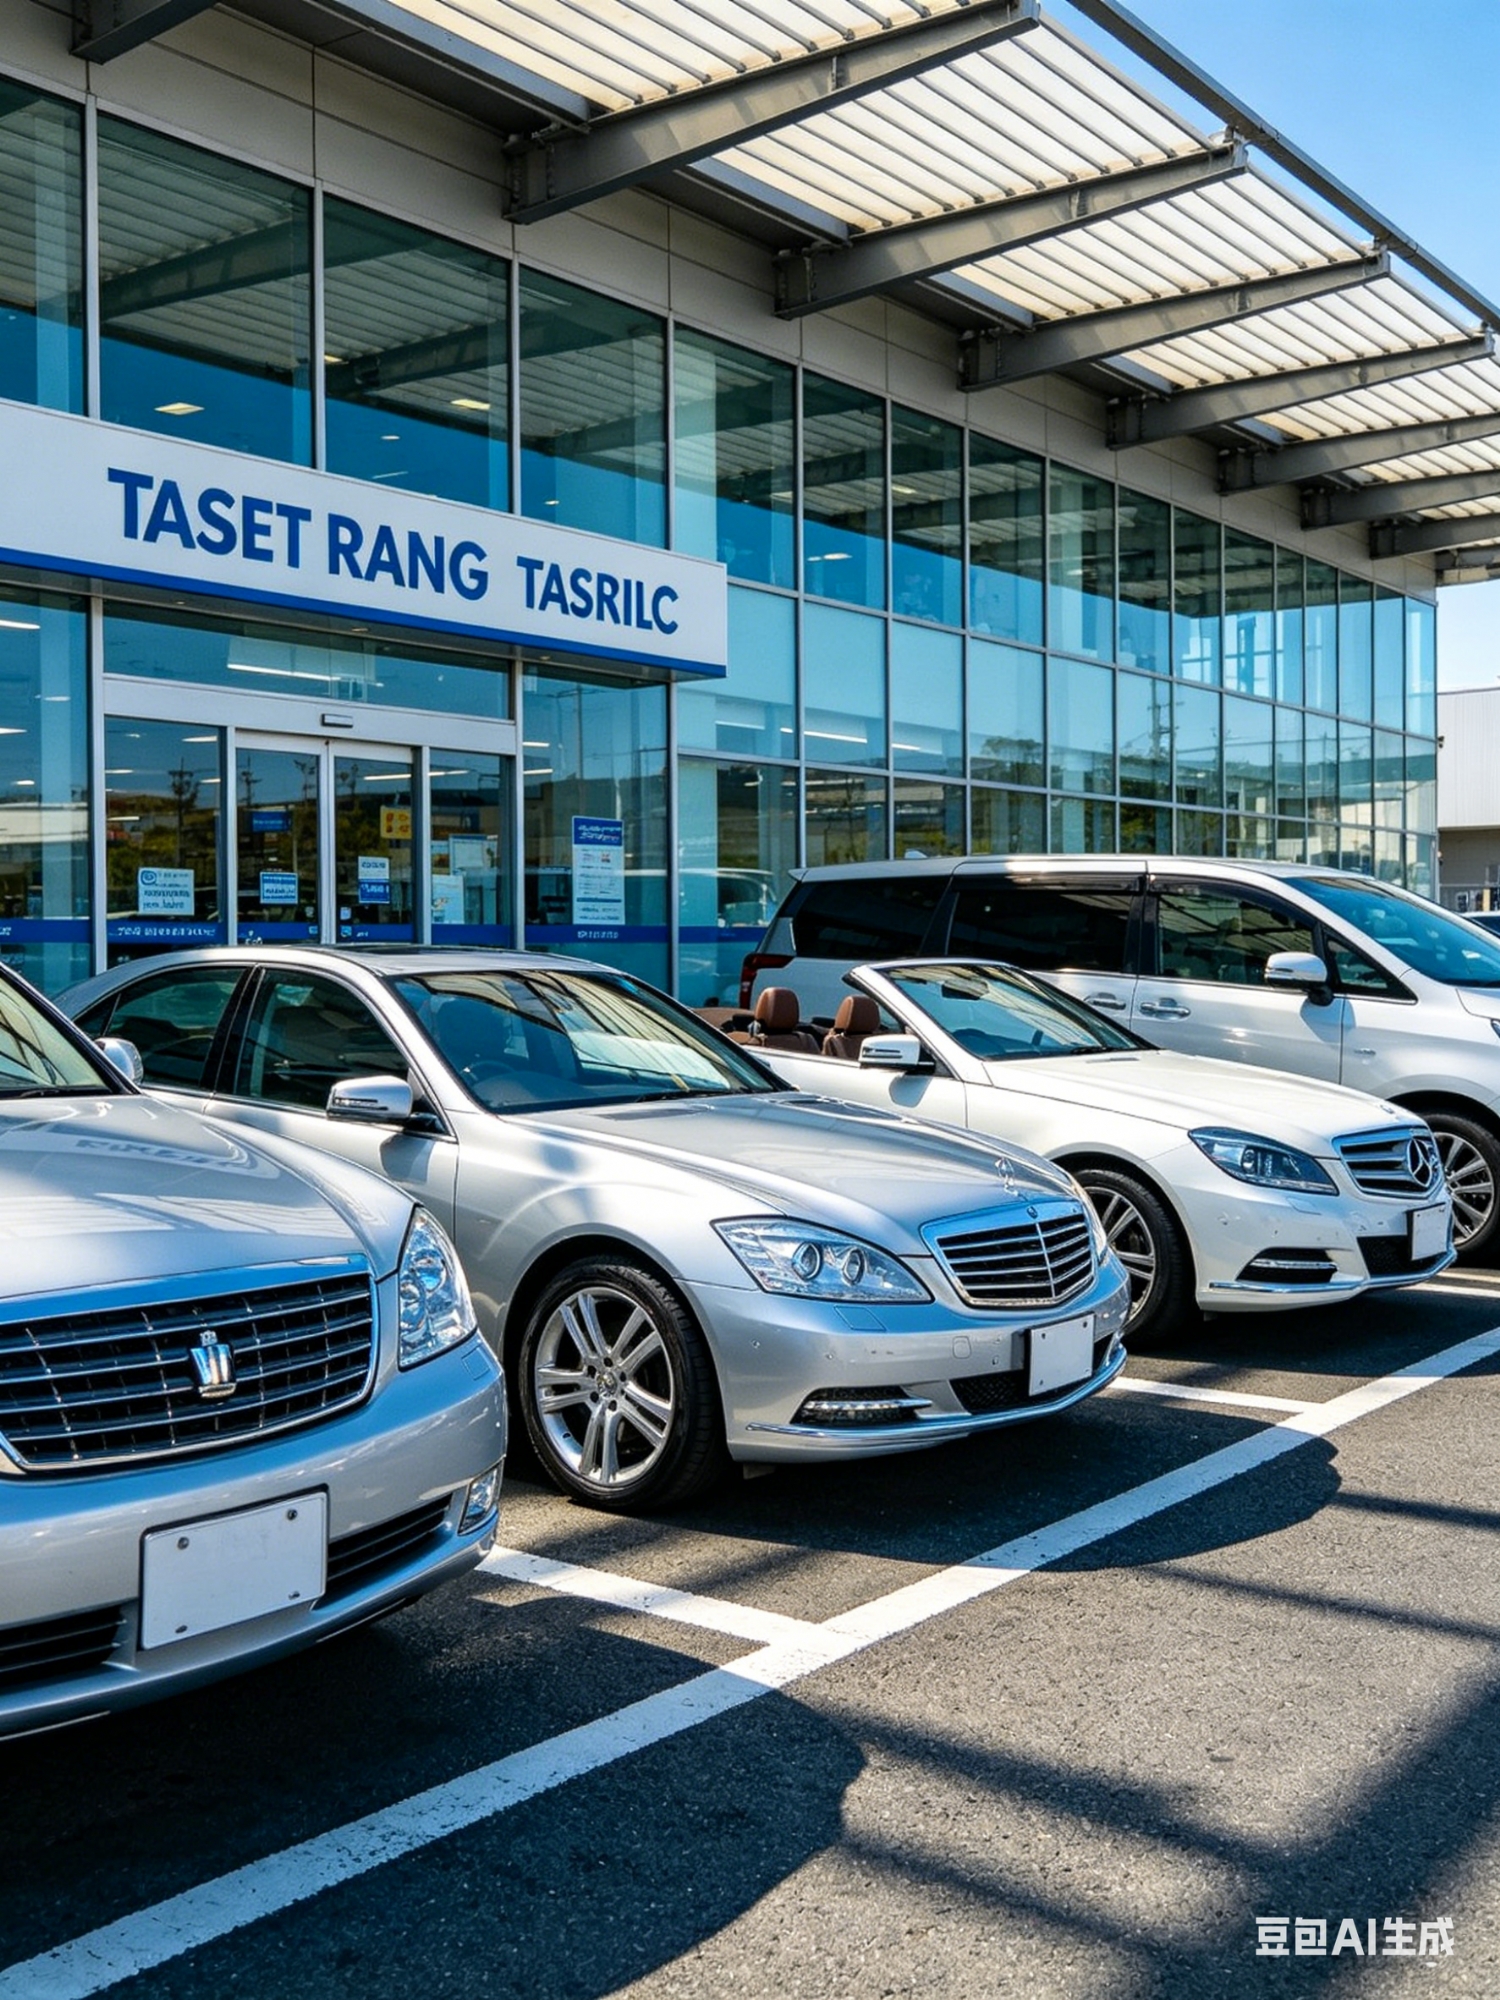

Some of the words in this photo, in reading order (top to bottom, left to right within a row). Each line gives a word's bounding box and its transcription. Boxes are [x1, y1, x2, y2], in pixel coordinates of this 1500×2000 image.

[107, 466, 312, 569] TASET
[327, 512, 489, 602] RANG
[516, 555, 679, 635] TASRILC
